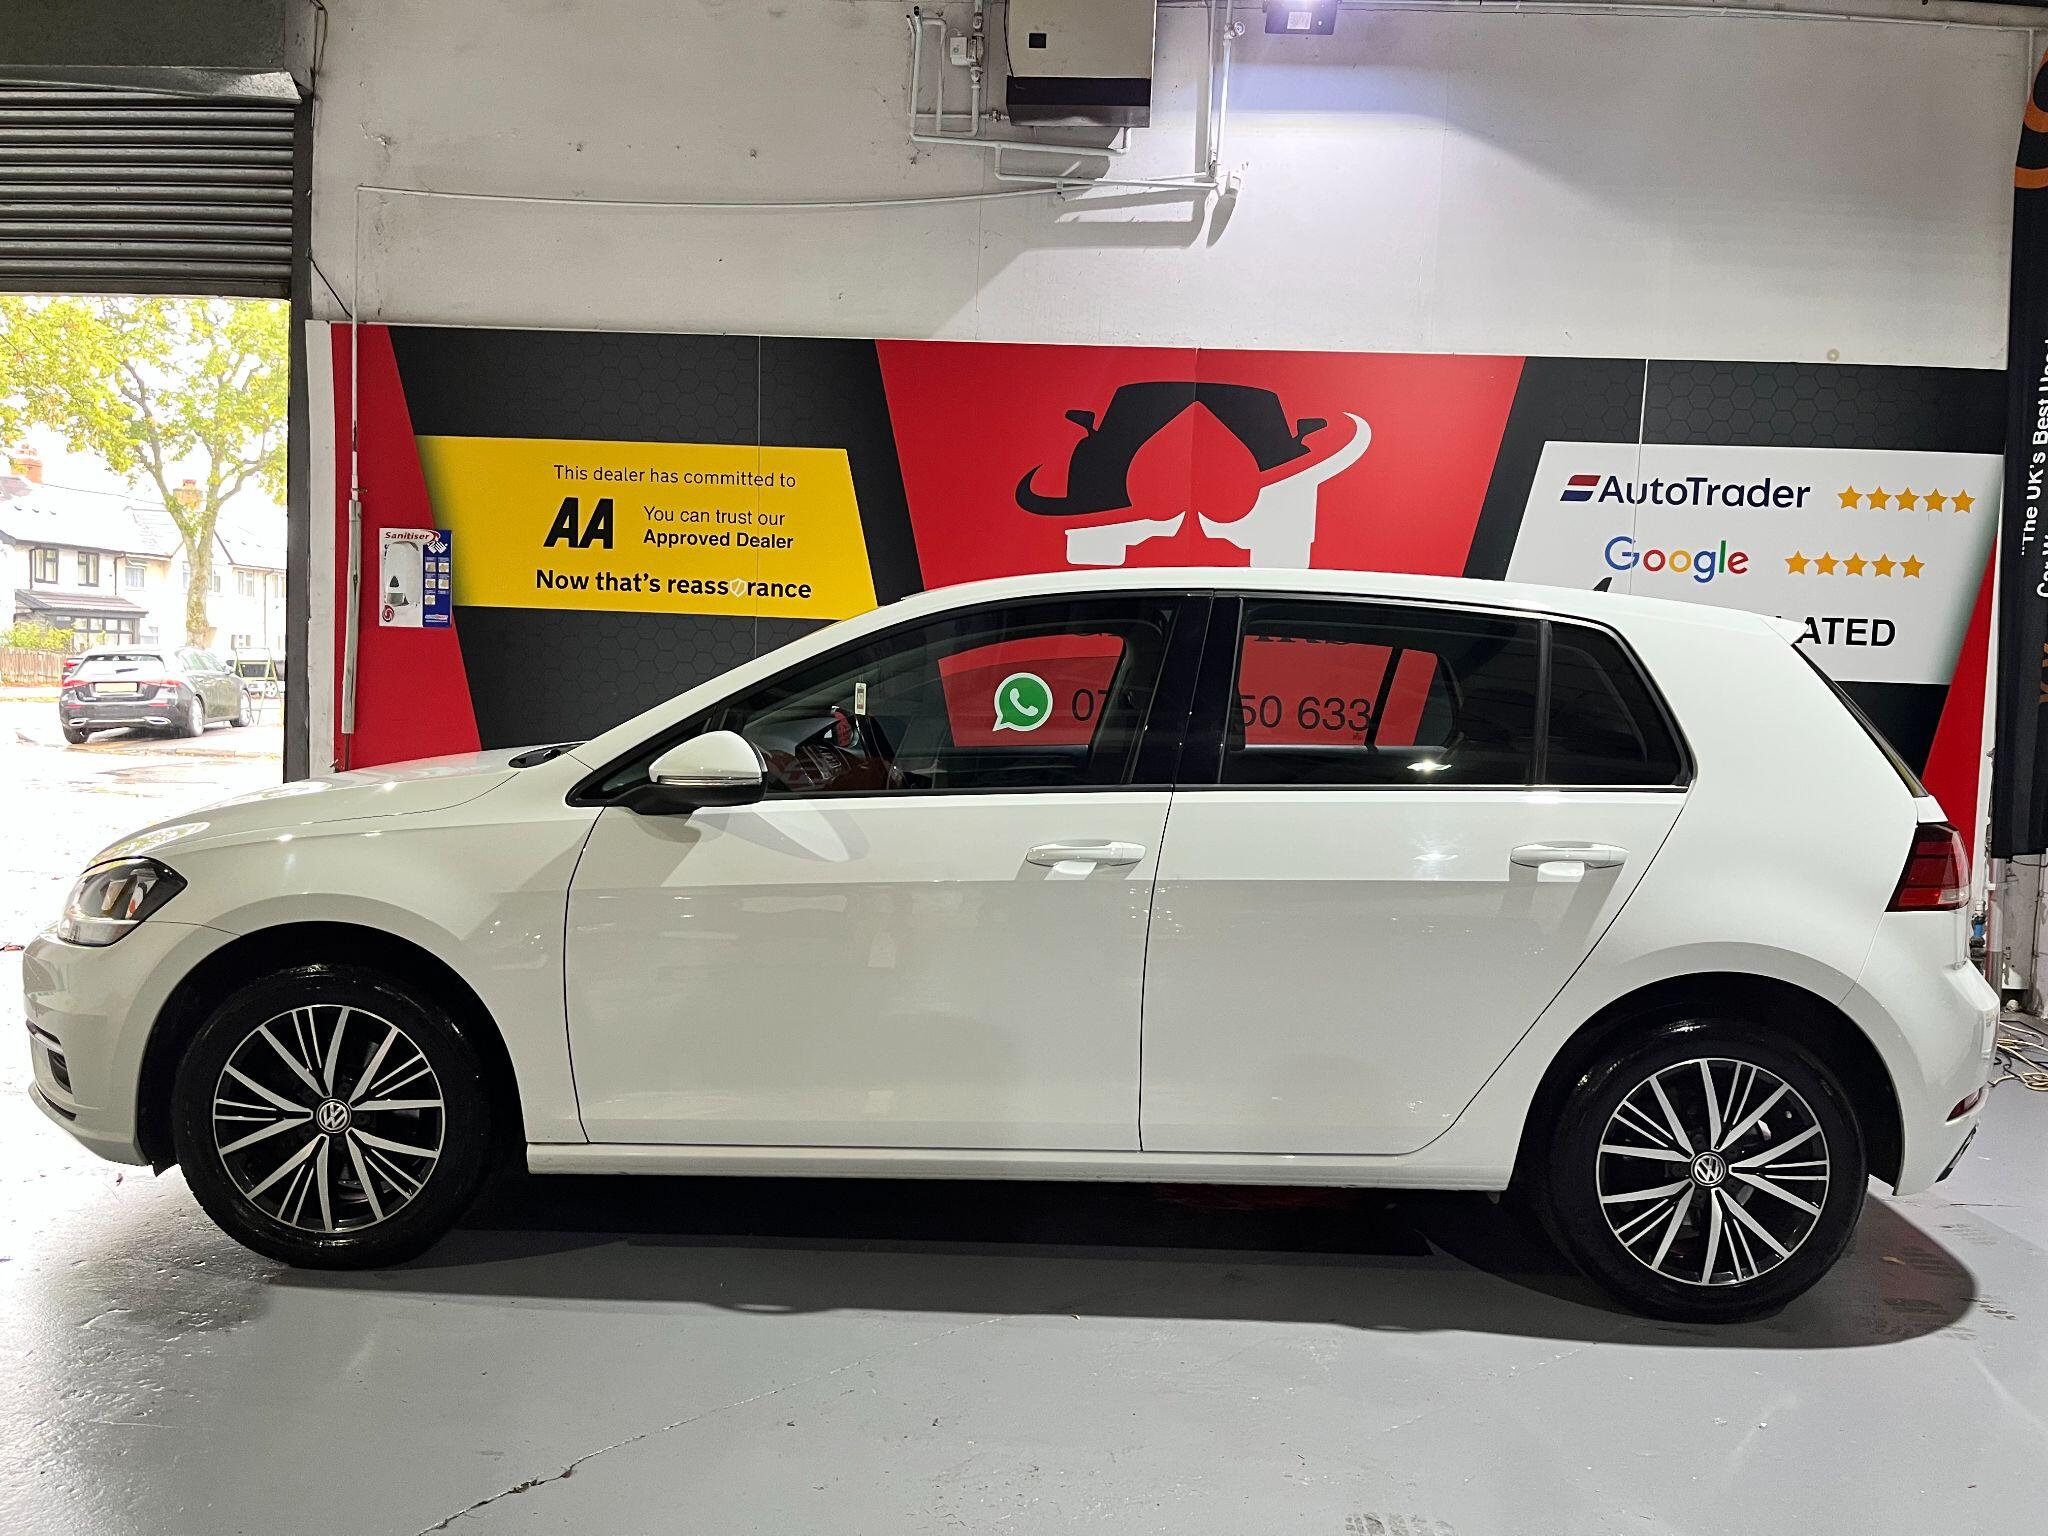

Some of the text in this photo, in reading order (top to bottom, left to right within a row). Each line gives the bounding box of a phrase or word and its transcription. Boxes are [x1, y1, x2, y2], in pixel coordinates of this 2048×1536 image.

[554, 464, 796, 488] This dealer has committed to
[2026, 451, 2046, 500] UK's
[1598, 476, 1811, 508] AutoTrader
[544, 497, 614, 549] AA
[643, 505, 786, 526] You can trust our
[384, 531, 430, 540] Sanitiser
[643, 528, 794, 549] Approved Dealer
[1604, 536, 1750, 583] Google
[536, 569, 812, 599] Now that's reassrance
[1793, 616, 1896, 647] ATED
[1297, 696, 1372, 732] 633
